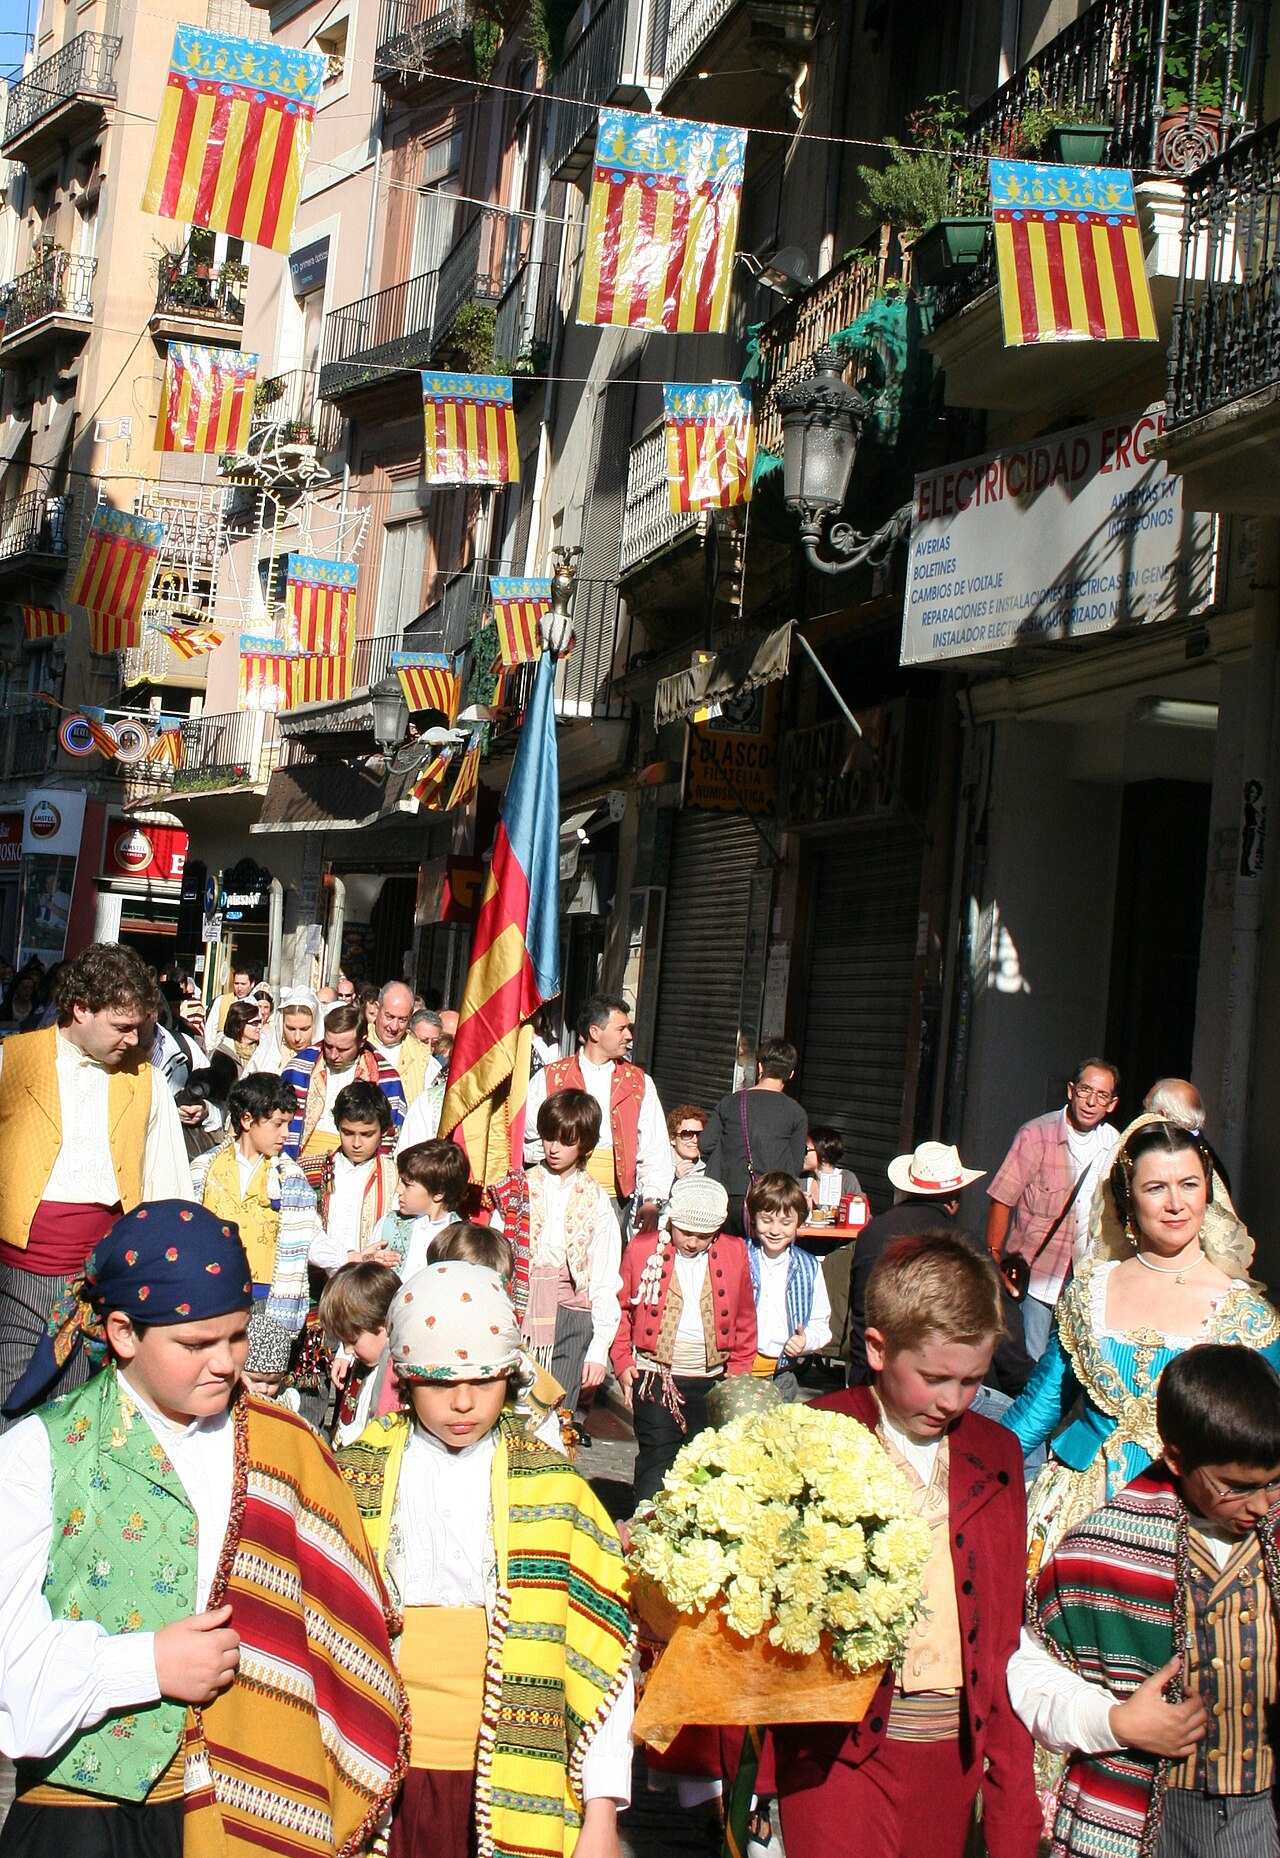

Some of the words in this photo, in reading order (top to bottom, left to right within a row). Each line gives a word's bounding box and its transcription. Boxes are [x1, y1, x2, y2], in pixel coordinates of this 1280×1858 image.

[918, 438, 1090, 522] ELECTRICIDAD
[1110, 484, 1158, 511] ANTENAS
[1109, 508, 1173, 538] INTERFONOS
[915, 536, 950, 557] AVERIAS
[913, 559, 956, 580] BOLETINES
[911, 584, 951, 604] CAMBIOS
[954, 582, 965, 596] DE
[967, 573, 1003, 594] VOLTAJE
[922, 601, 986, 626] REPARACIONES
[988, 599, 994, 613] E
[996, 586, 1062, 613] INSTALACIONES
[1125, 571, 1139, 589] EN
[933, 626, 984, 648] INSTALADOR
[988, 617, 1042, 639] ELECTRICISTA
[1045, 603, 1106, 629] AUTORIZADO
[700, 739, 769, 769] BLASCO
